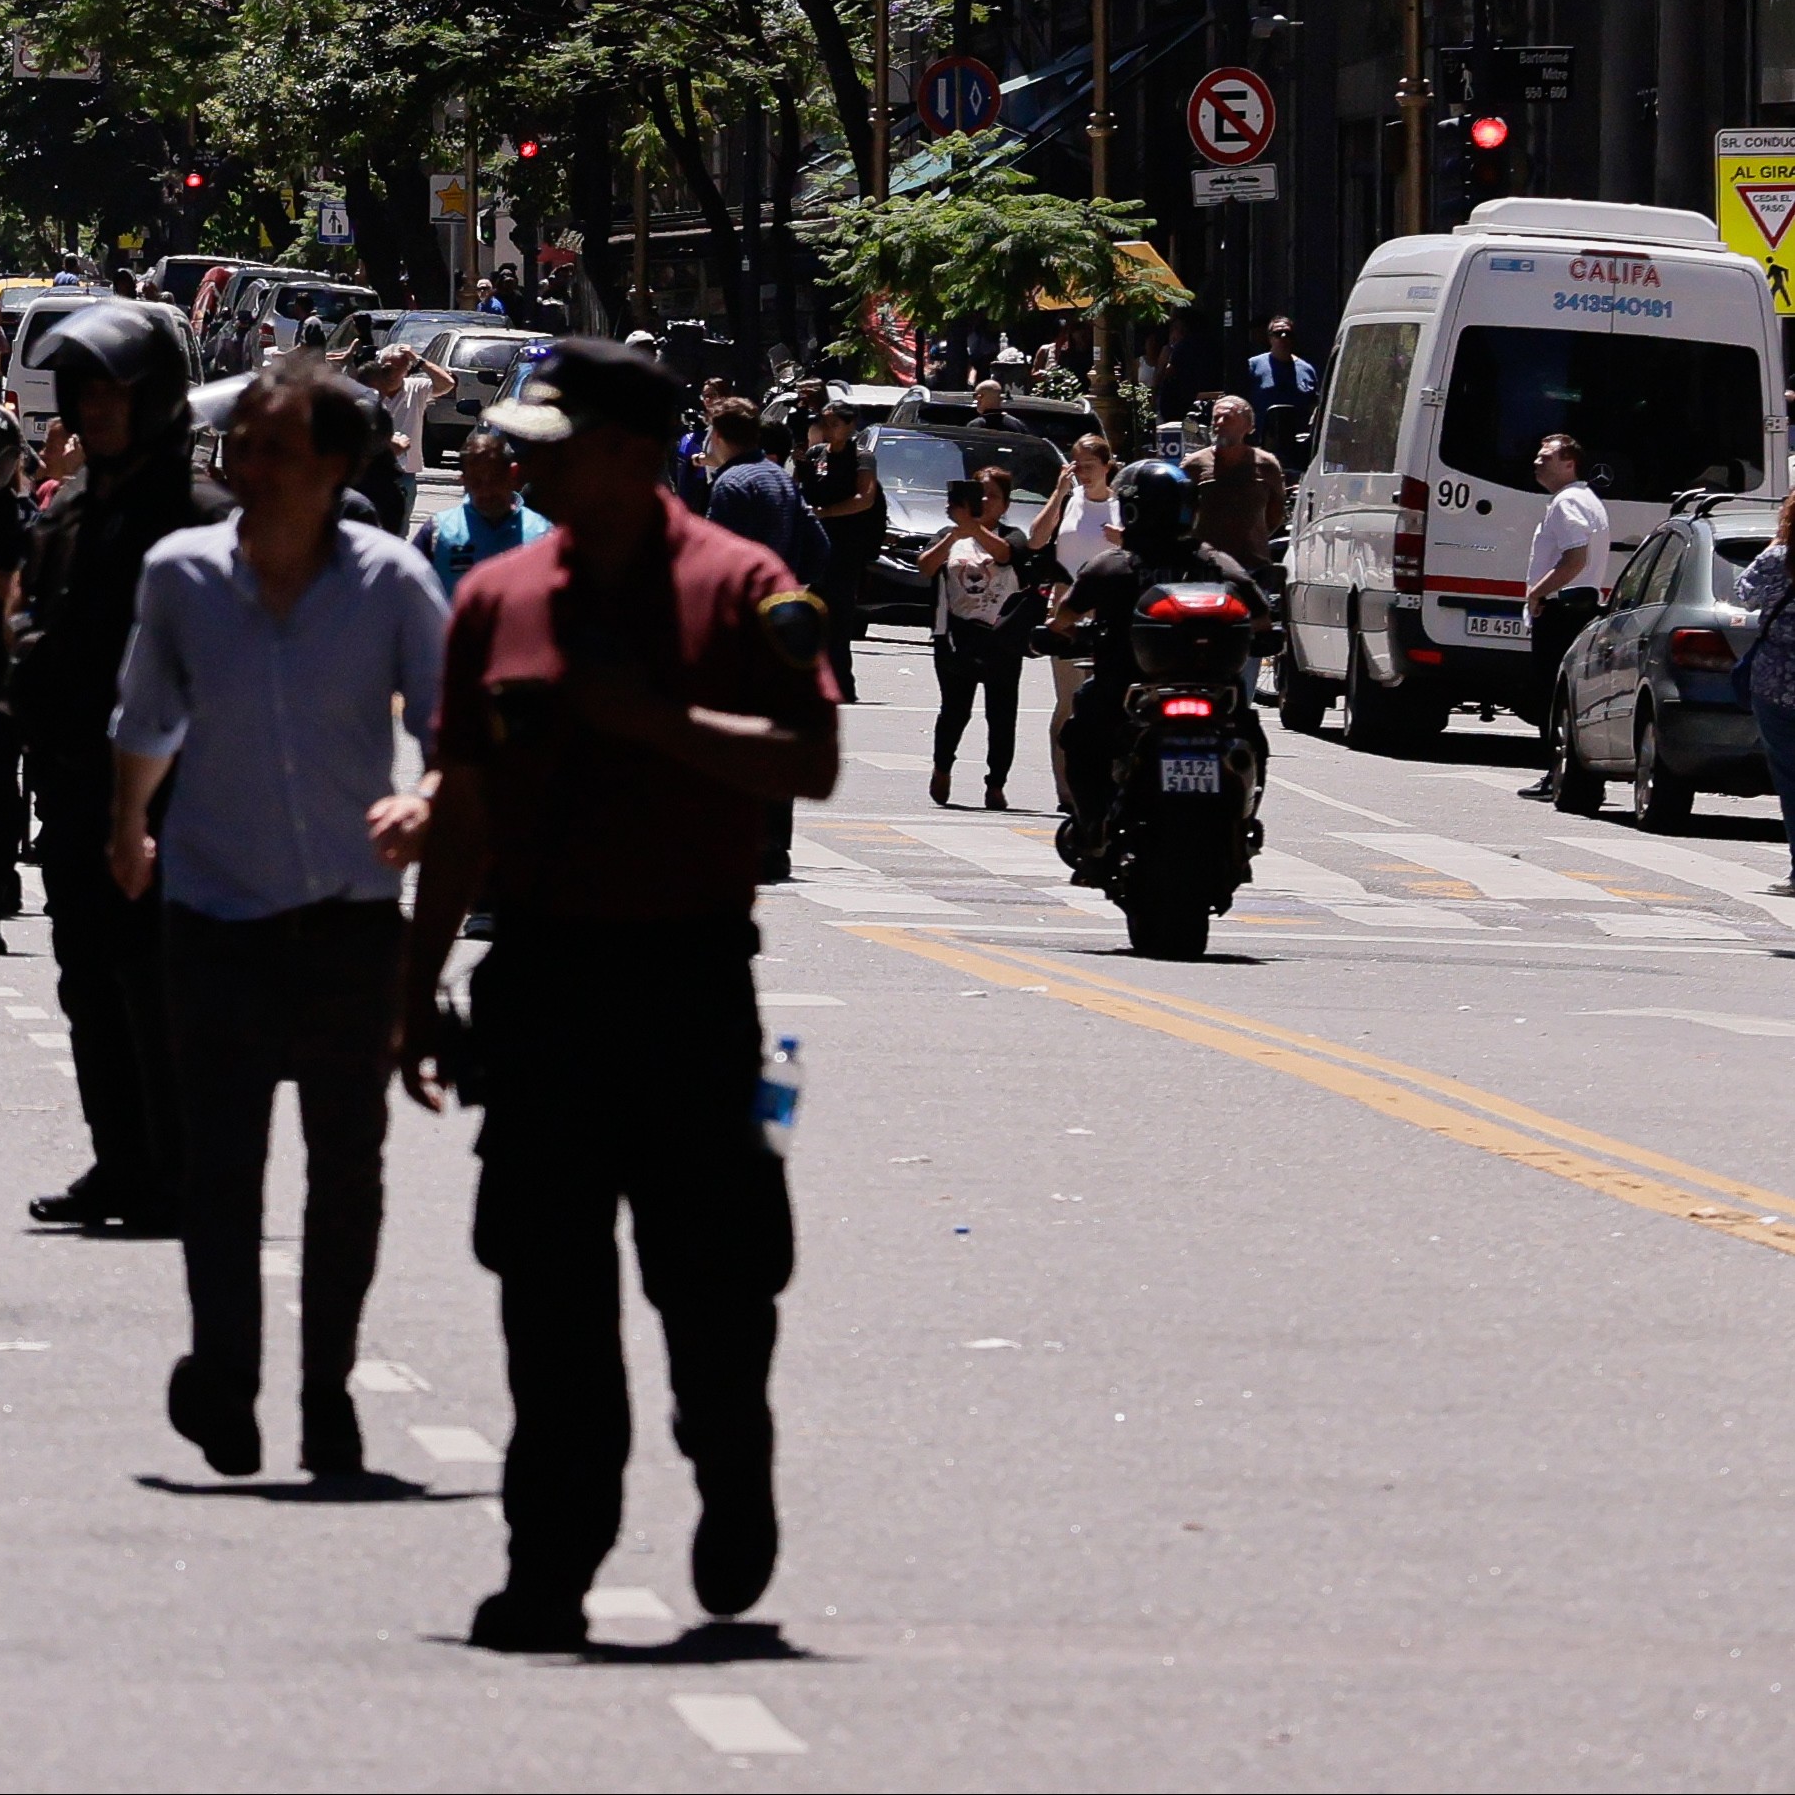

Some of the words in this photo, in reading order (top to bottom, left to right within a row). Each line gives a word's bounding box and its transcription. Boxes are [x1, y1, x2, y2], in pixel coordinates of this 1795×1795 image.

[1542, 67, 1568, 80] Mitre
[1735, 165, 1756, 179] AL
[1780, 194, 1793, 202] EL
[1760, 204, 1786, 213] PASO
[1569, 257, 1661, 288] CALIFA
[1437, 479, 1471, 509] 90
[1471, 620, 1489, 633] AB
[1493, 621, 1521, 635] 450
